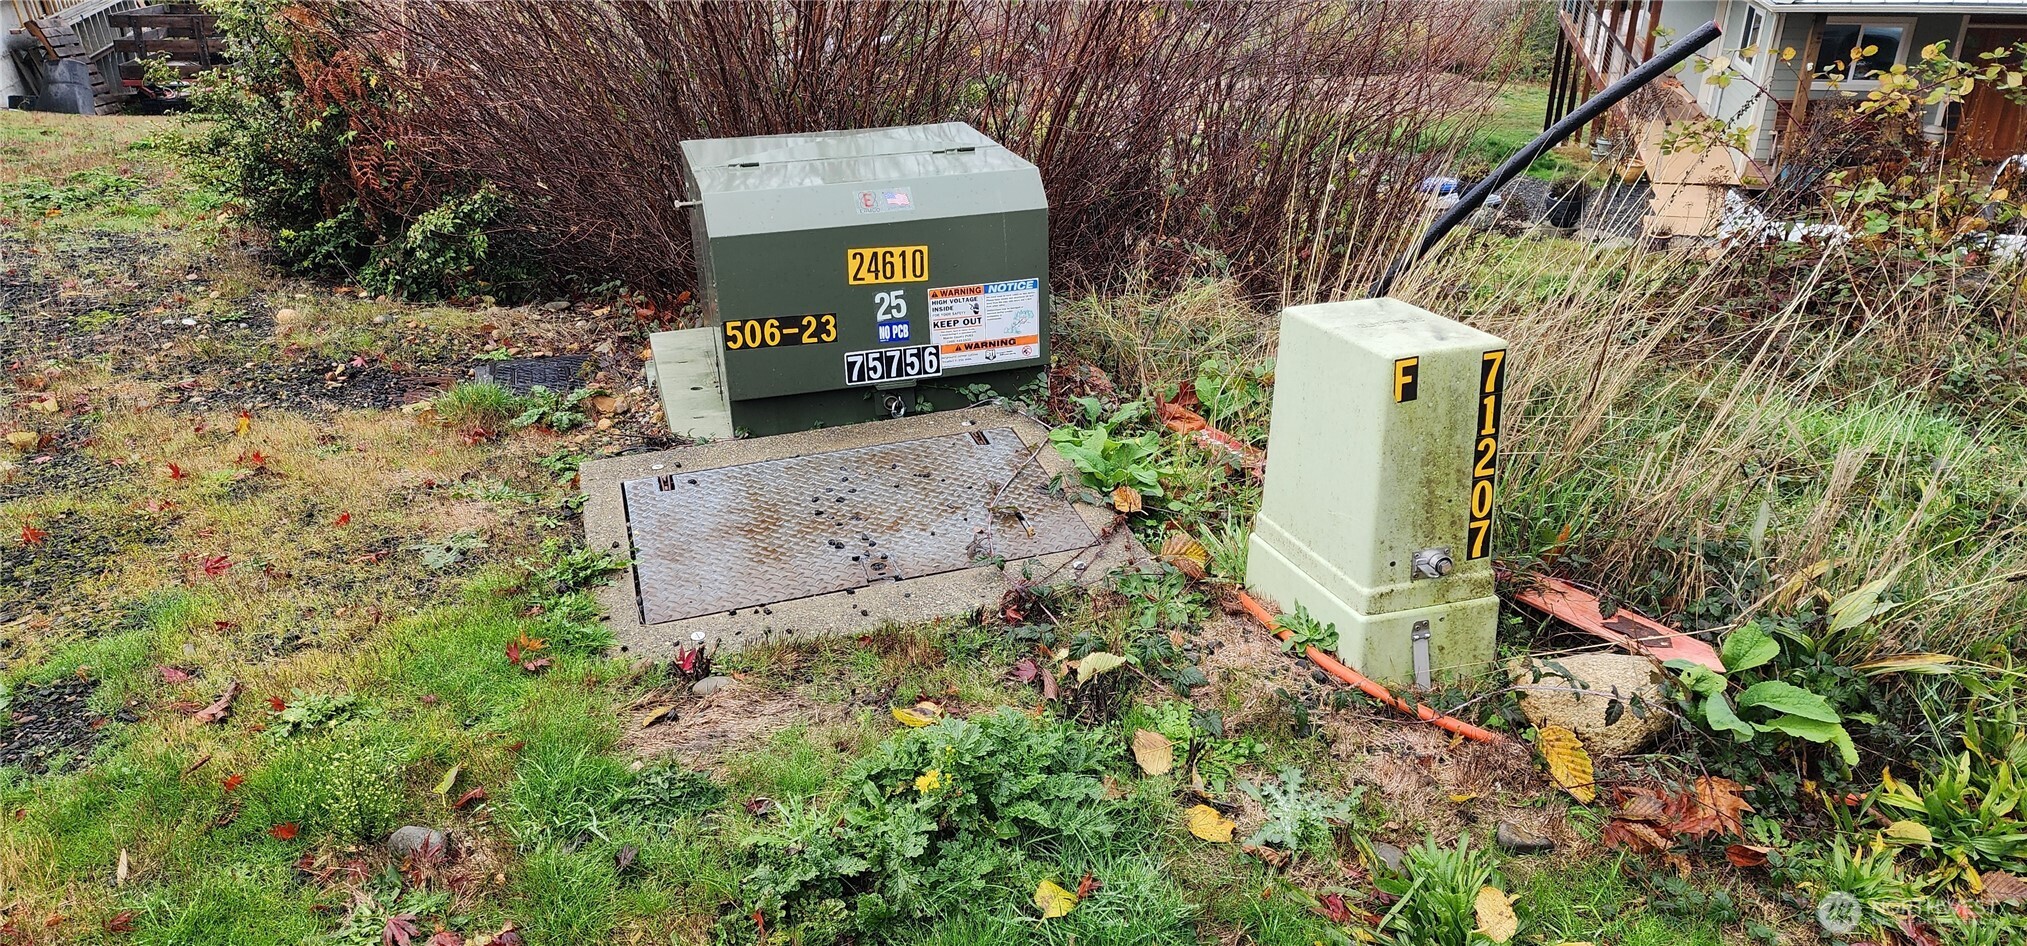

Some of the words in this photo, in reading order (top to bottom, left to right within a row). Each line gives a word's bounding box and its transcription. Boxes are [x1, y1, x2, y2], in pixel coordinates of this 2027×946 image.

[852, 249, 925, 281] 24610
[940, 285, 982, 297] WARNING
[988, 280, 1034, 293] NOTICE
[875, 290, 907, 322] 25
[950, 296, 978, 304] VOLTAGE
[725, 314, 837, 349] 506-23
[879, 325, 890, 339] NO
[892, 324, 908, 338] PCB
[933, 319, 959, 329] KEEP
[962, 317, 982, 326] OUT
[964, 338, 1017, 350] WARNING
[847, 347, 939, 381] 75756
[1395, 357, 1417, 402] F
[1469, 350, 1505, 558] 71207
